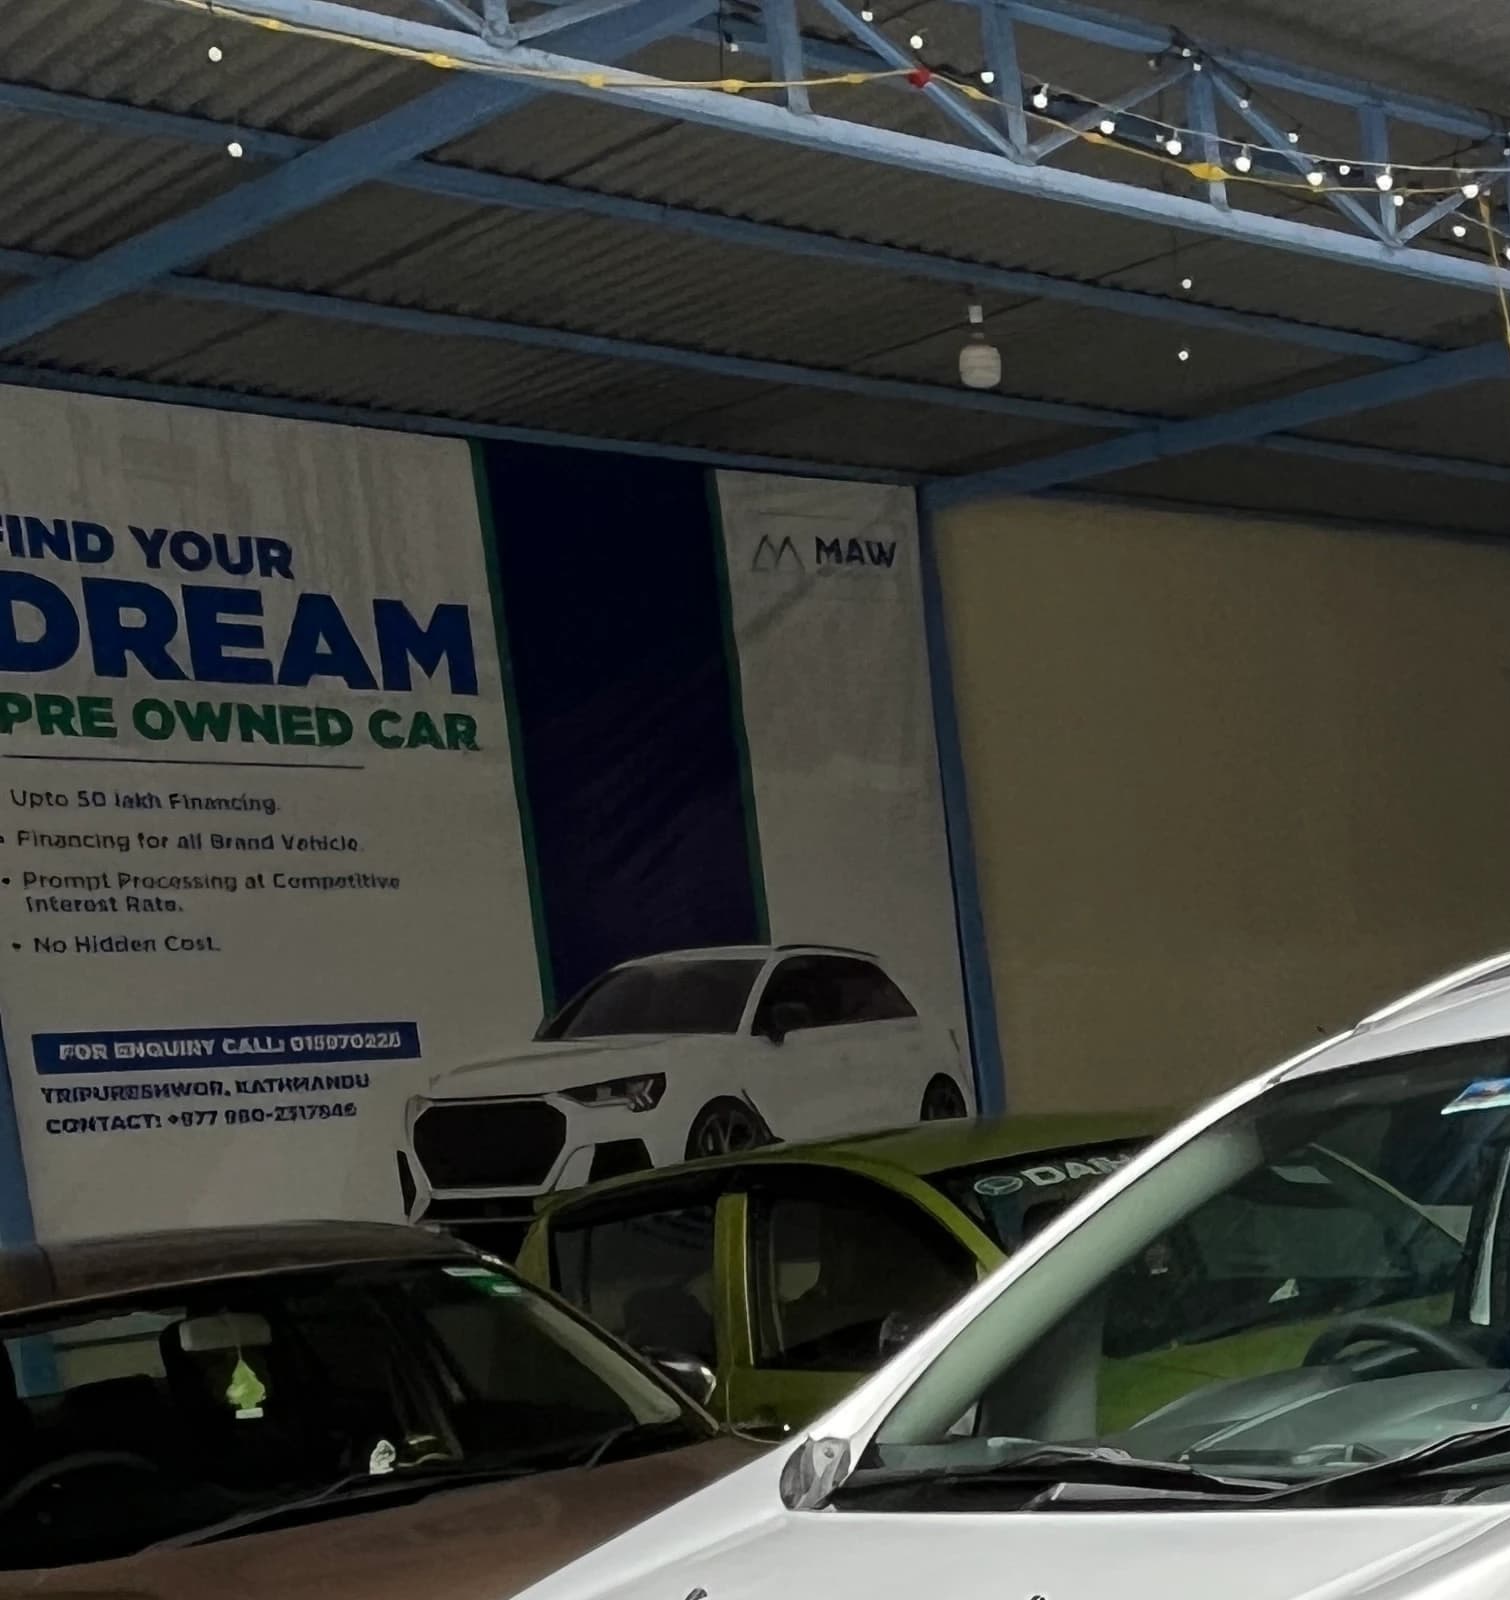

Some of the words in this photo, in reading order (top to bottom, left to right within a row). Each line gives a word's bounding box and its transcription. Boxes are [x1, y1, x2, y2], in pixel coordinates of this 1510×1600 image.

[0, 514, 114, 564] IND
[128, 525, 294, 580] YOUR
[815, 535, 897, 568] MAW
[0, 570, 479, 696] DREAM
[0, 691, 118, 739] PRE
[132, 697, 354, 747] OWNED
[368, 708, 482, 752] CAR
[10, 788, 69, 810] Upto
[78, 790, 107, 808] 50
[114, 790, 162, 809] lakh
[17, 830, 130, 853] Financing
[138, 832, 169, 850] for
[177, 832, 202, 850] all
[210, 833, 274, 852] Brand
[23, 871, 111, 892] Prompt
[117, 871, 238, 893] Processing
[245, 872, 265, 890] at
[272, 871, 401, 891] Competitive
[25, 895, 118, 914] Interest
[125, 895, 185, 914] Rate.
[33, 936, 67, 954] No
[74, 935, 157, 954] Hidden
[164, 934, 222, 953] Cost.
[59, 1042, 108, 1061] FOR
[114, 1037, 216, 1060] ENQUIRY
[235, 1072, 370, 1095] KATHMANDU
[46, 1112, 162, 1135] CONTACT:
